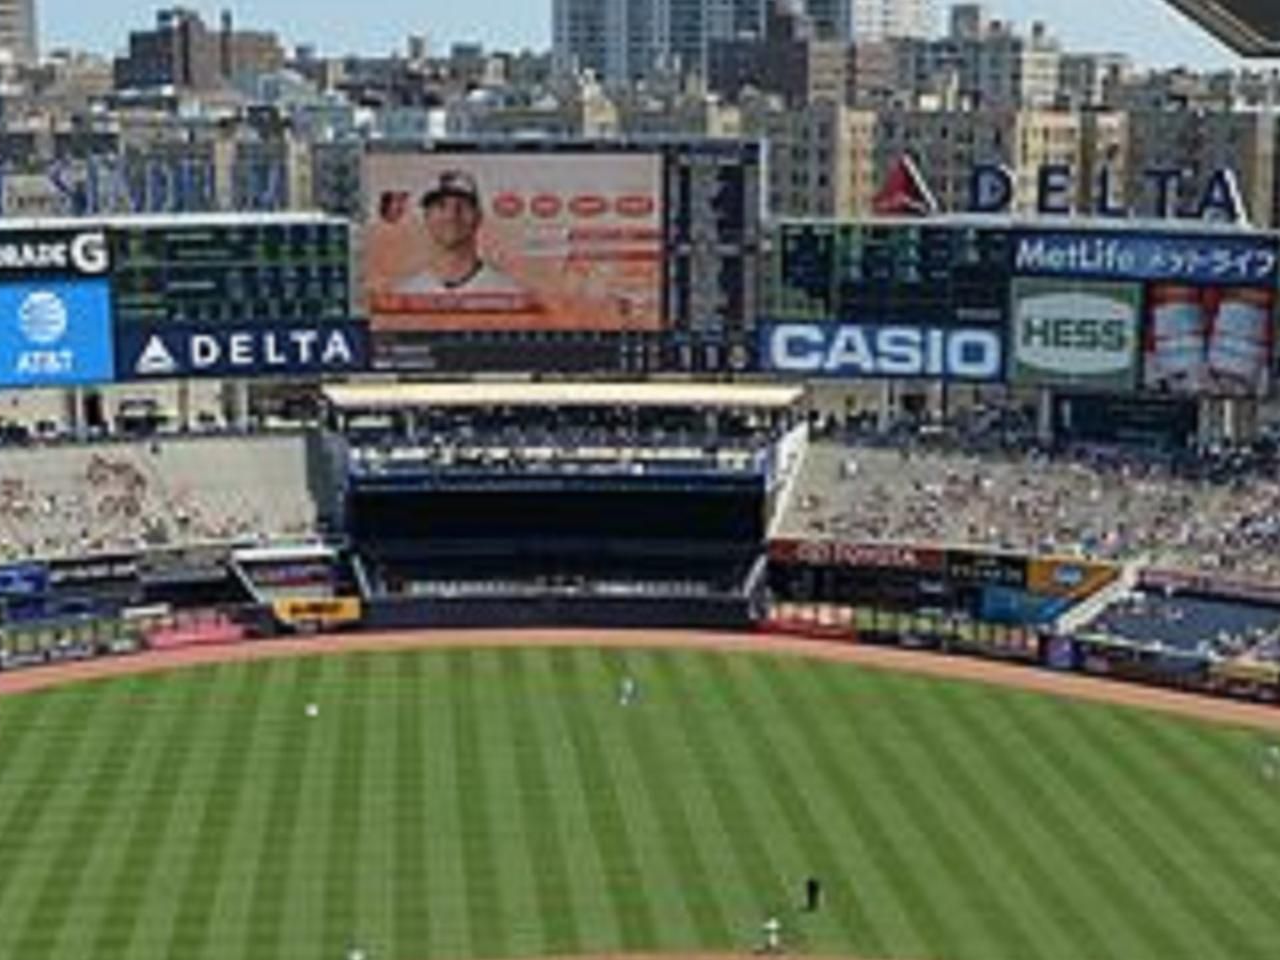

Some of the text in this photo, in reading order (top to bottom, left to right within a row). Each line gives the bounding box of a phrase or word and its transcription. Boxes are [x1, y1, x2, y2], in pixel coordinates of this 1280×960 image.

[971, 163, 1246, 216] DELTA
[71, 233, 109, 273] G
[1016, 238, 1134, 271] MetLife
[191, 330, 352, 367] DELTA
[768, 325, 1001, 376] CASIO
[1021, 317, 1125, 351] HESS
[14, 350, 75, 373] AT&T
